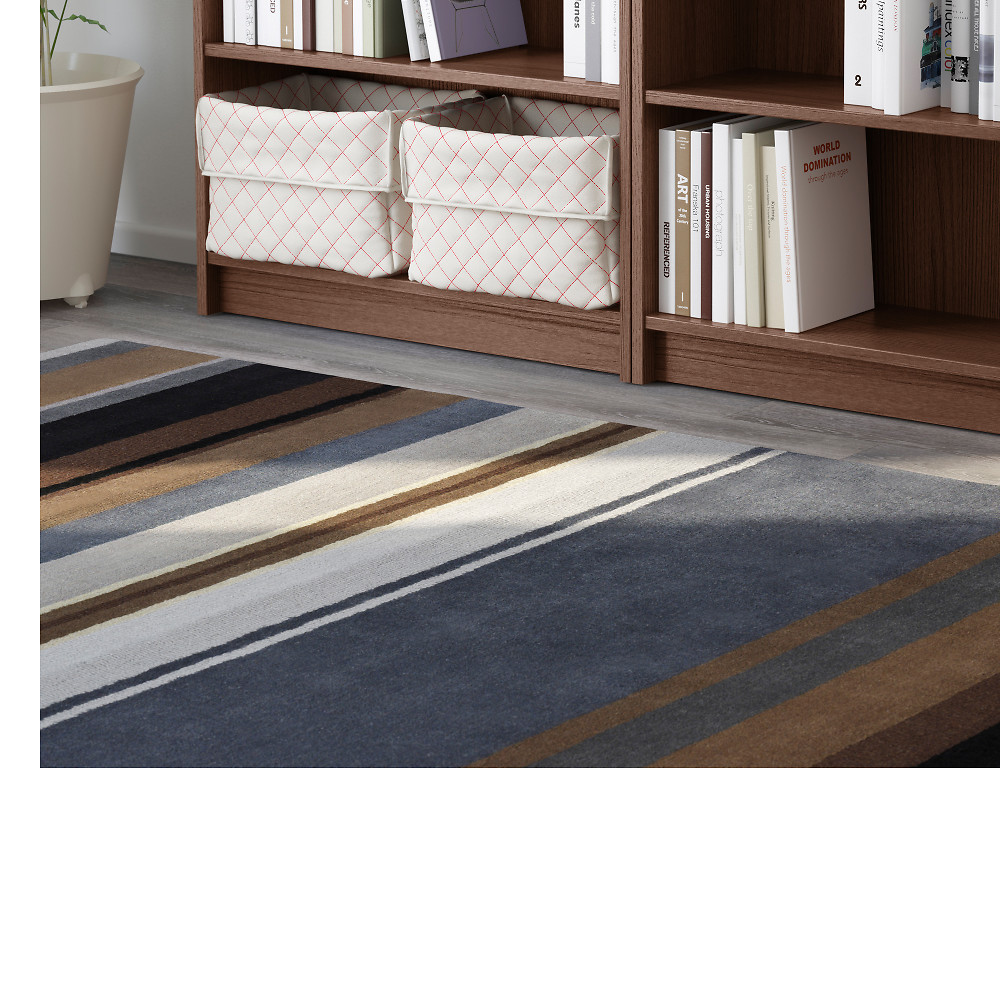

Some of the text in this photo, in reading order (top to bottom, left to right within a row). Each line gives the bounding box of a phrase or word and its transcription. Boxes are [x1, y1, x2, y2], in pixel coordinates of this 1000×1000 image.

[855, 75, 863, 87] 2
[813, 139, 841, 156] WORLD
[803, 151, 852, 173] DOMINATION
[780, 165, 788, 186] World
[808, 168, 849, 184] through the ages
[677, 173, 688, 203] ART
[745, 183, 754, 231] Over the top
[781, 187, 789, 226] domination
[714, 189, 726, 257] photograph
[783, 226, 791, 253] through
